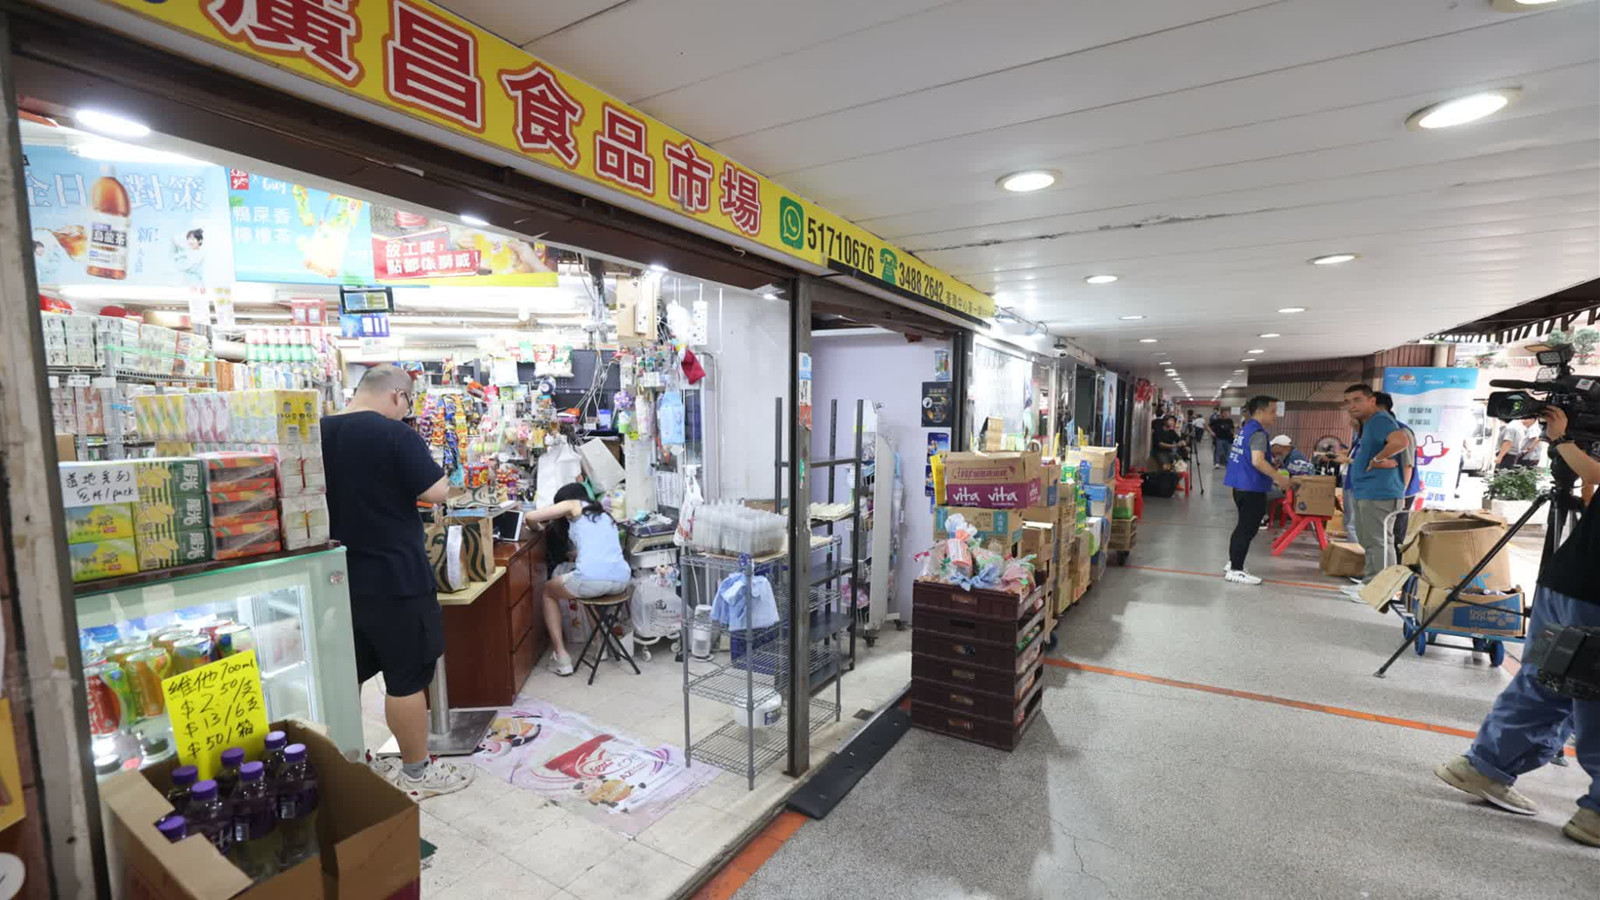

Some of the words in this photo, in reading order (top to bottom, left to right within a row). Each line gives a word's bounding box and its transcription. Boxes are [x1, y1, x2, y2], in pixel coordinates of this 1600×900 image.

[93, 230, 126, 246] 烏龍茶
[807, 217, 875, 274] 51710676
[899, 262, 922, 293] 3488
[924, 275, 944, 302] 2642
[953, 486, 981, 502] vita
[988, 486, 1018, 502] vita
